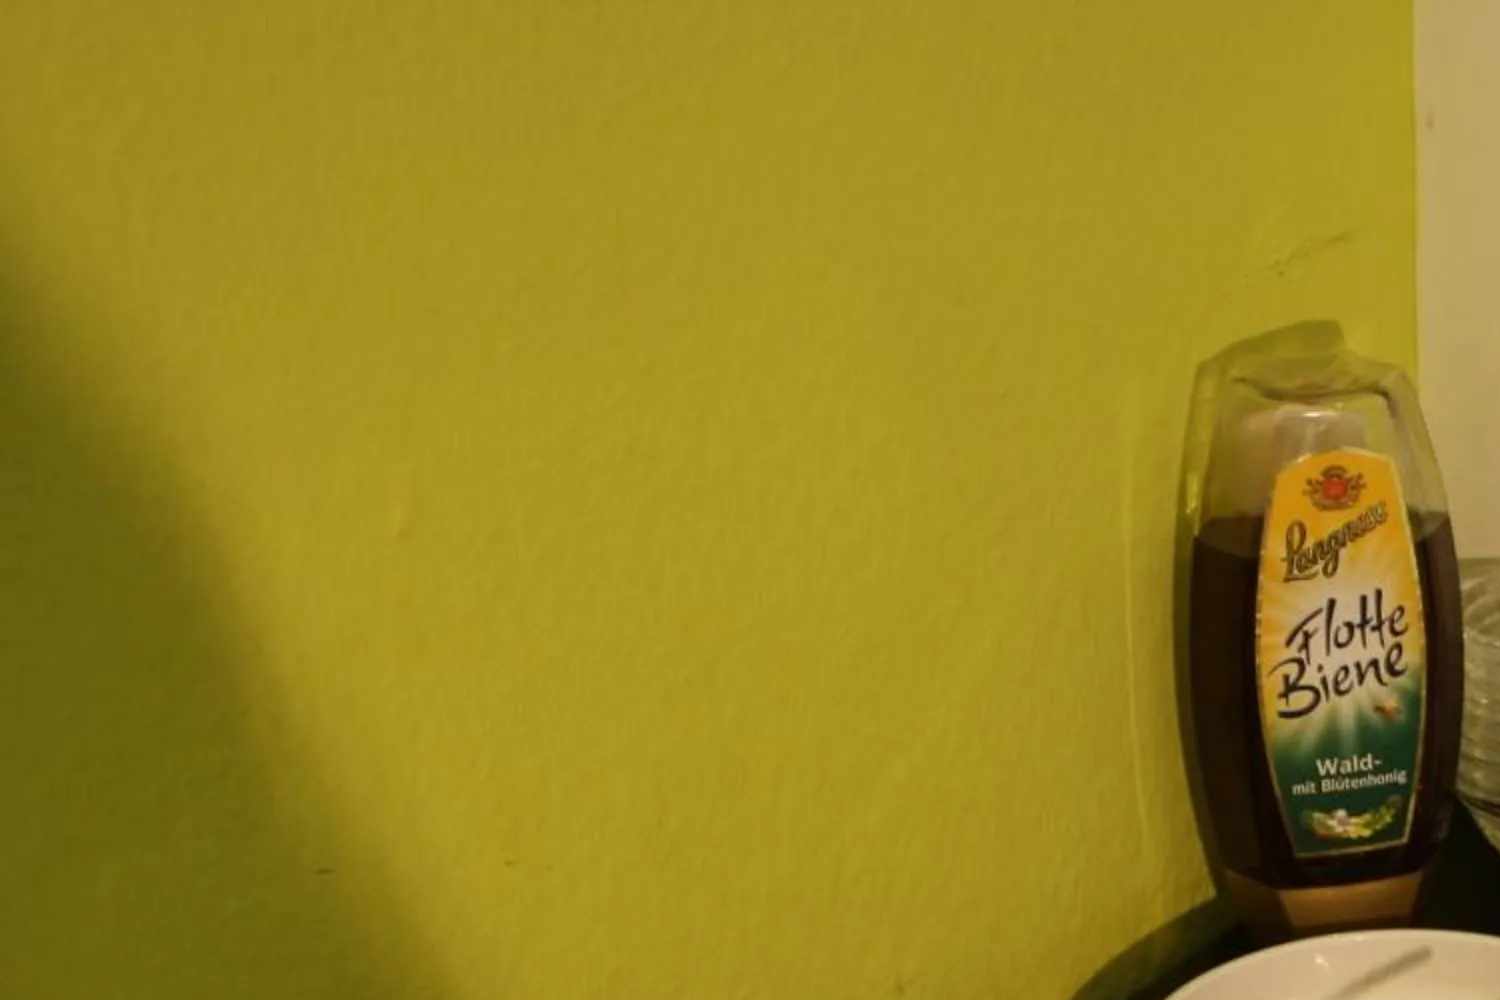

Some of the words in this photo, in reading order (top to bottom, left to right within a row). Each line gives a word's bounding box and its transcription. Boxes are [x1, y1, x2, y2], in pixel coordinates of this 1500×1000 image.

[1285, 588, 1409, 665] Flotte
[1268, 639, 1409, 720] Biene
[1292, 780, 1316, 795] mit
[1315, 753, 1383, 777] Wald-
